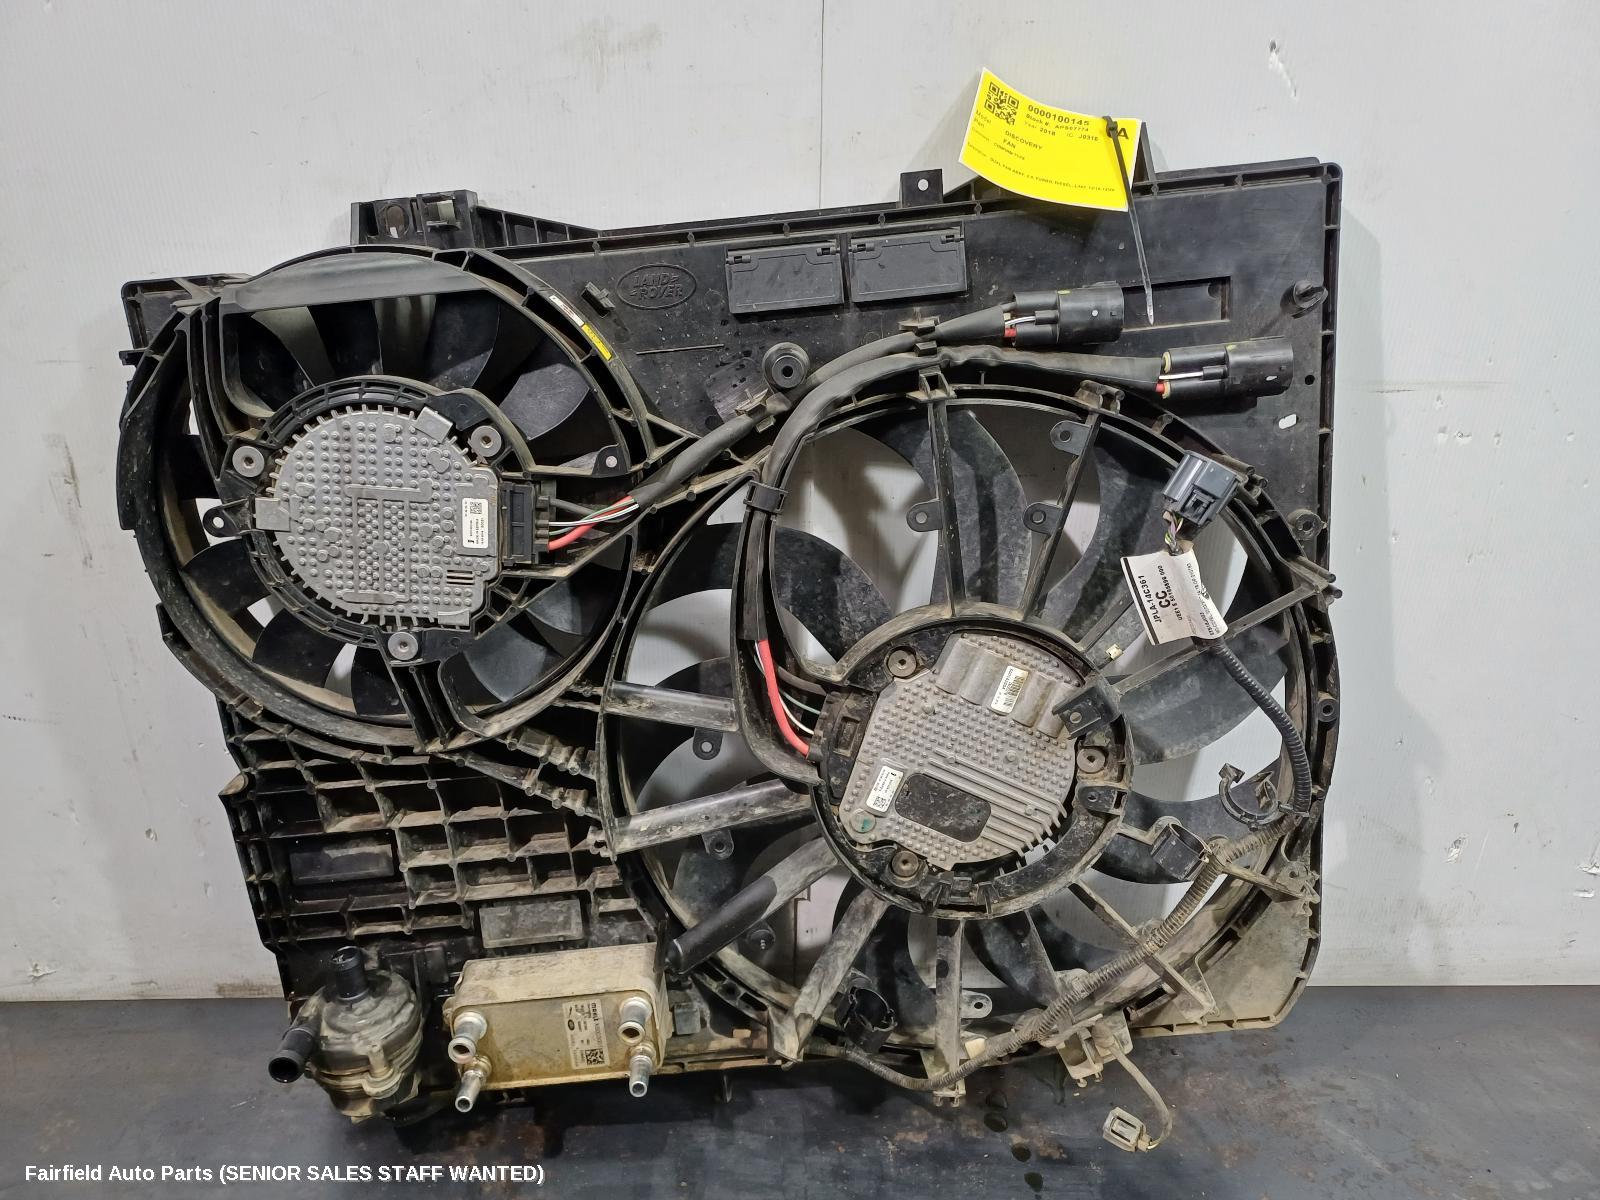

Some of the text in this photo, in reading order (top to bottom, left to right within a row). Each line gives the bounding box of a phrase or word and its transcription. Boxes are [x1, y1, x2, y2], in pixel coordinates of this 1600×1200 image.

[1026, 113, 1043, 124] Stock
[1028, 104, 1090, 126] 0000100145
[1002, 138, 1016, 149] FAN
[1005, 130, 1043, 150] DISCOVERY
[633, 271, 671, 288] LAND
[640, 283, 683, 299] ROVER
[1138, 575, 1162, 623] JPLA-14C361
[1155, 590, 1171, 608] CC
